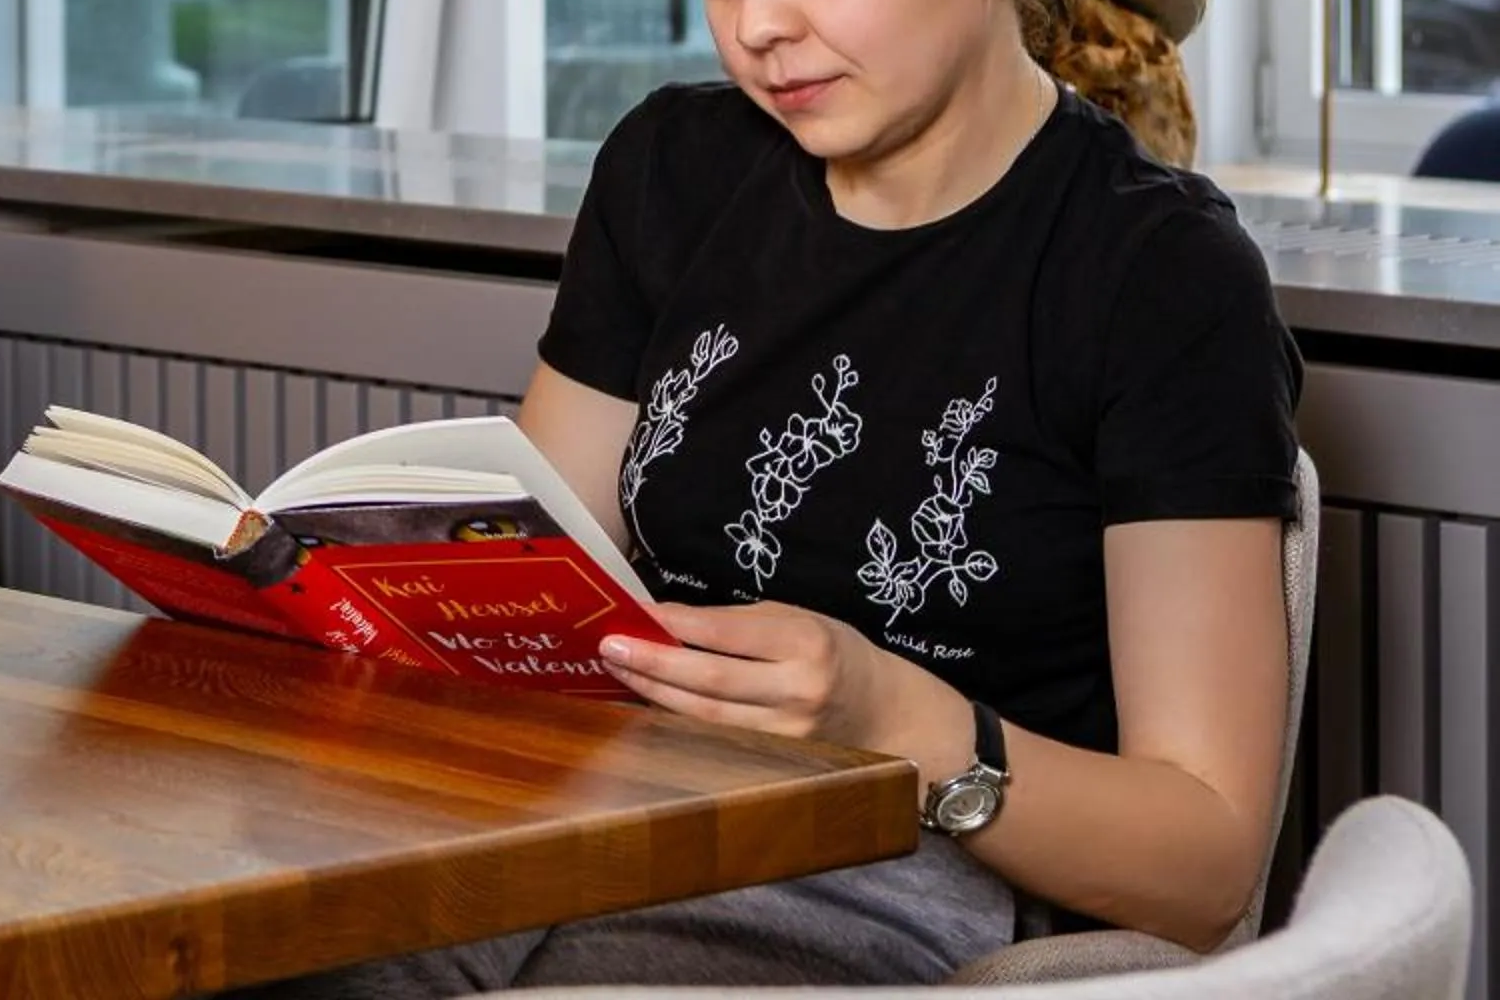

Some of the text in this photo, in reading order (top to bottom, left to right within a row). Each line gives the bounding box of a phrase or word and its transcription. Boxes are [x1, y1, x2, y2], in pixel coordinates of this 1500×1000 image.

[371, 575, 445, 599] Kai
[436, 592, 567, 621] Hensel
[427, 630, 563, 651] Wo ist
[883, 631, 975, 659] Wild Rose
[472, 655, 605, 676] Valent
